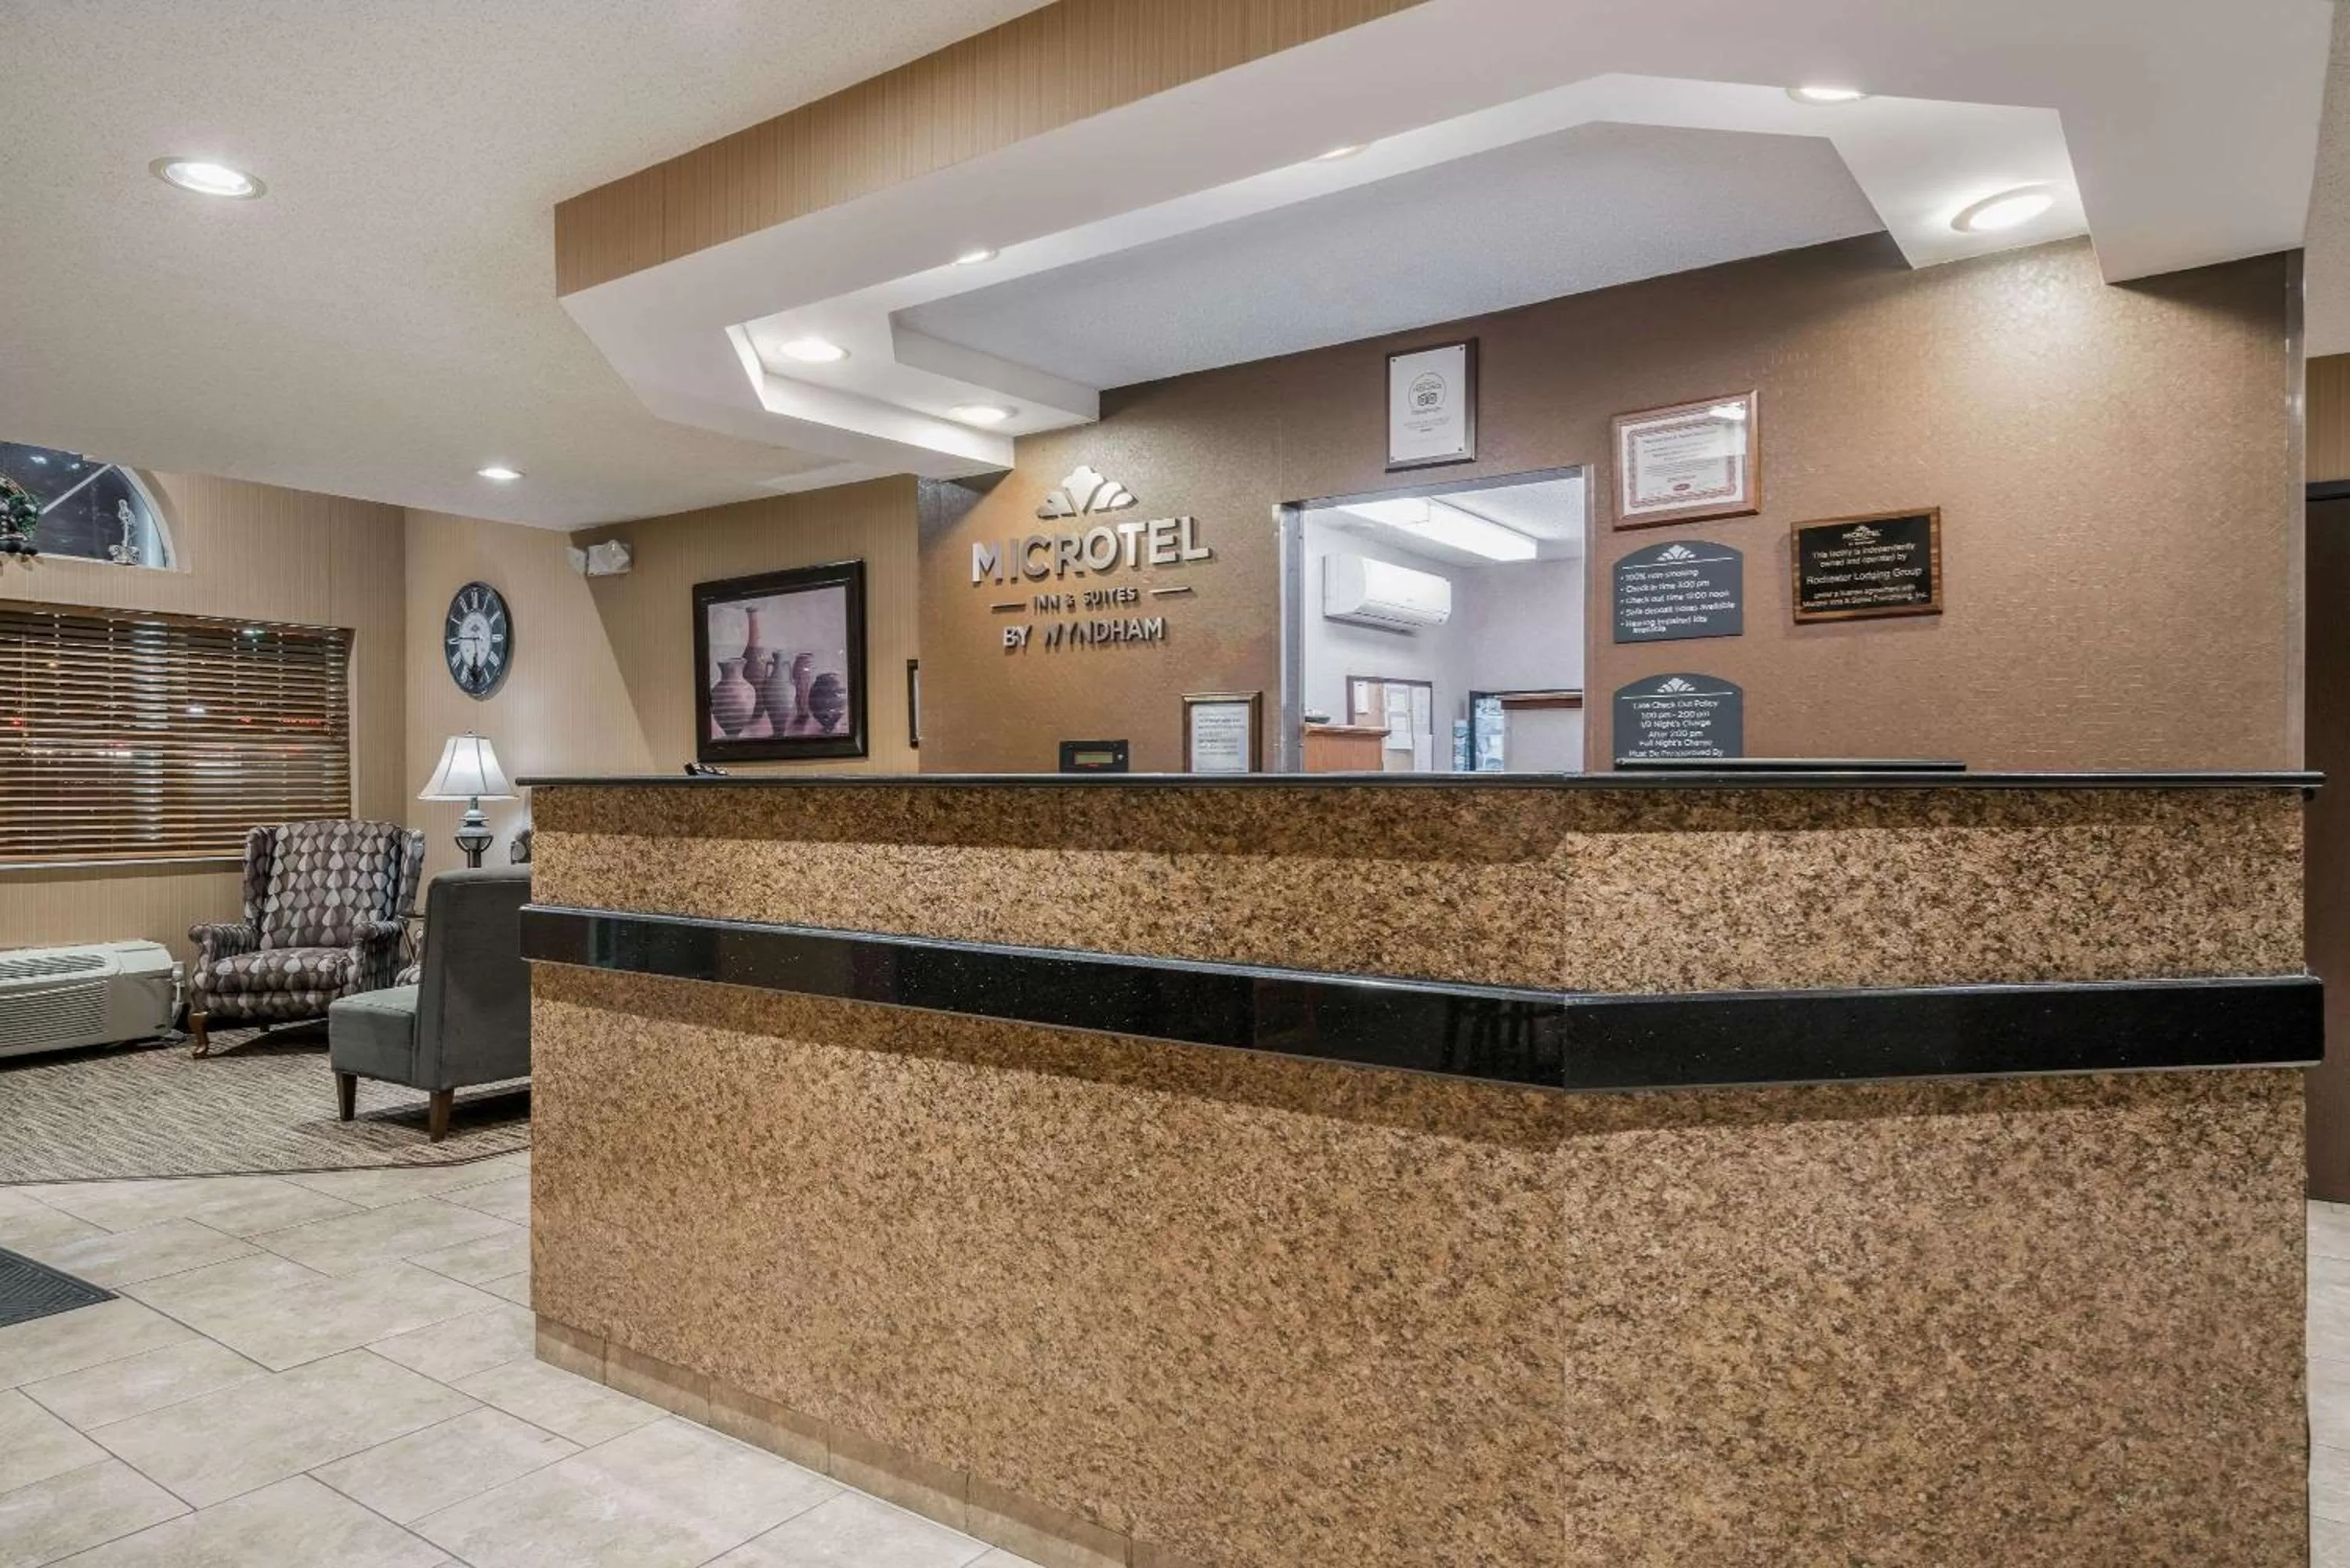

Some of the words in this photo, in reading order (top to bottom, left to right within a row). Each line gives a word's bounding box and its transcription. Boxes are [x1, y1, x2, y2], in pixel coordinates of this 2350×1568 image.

[971, 515, 1211, 584] MICROTEL
[1854, 569, 1890, 580] Lodging
[1893, 568, 1922, 577] Group
[1033, 594, 1060, 612] INN
[1083, 587, 1138, 608] SUITES
[1003, 624, 1032, 649] BY
[1043, 616, 1166, 649] WYNDHAM
[1694, 699, 1719, 708] Policy
[1654, 720, 1680, 728] Night's
